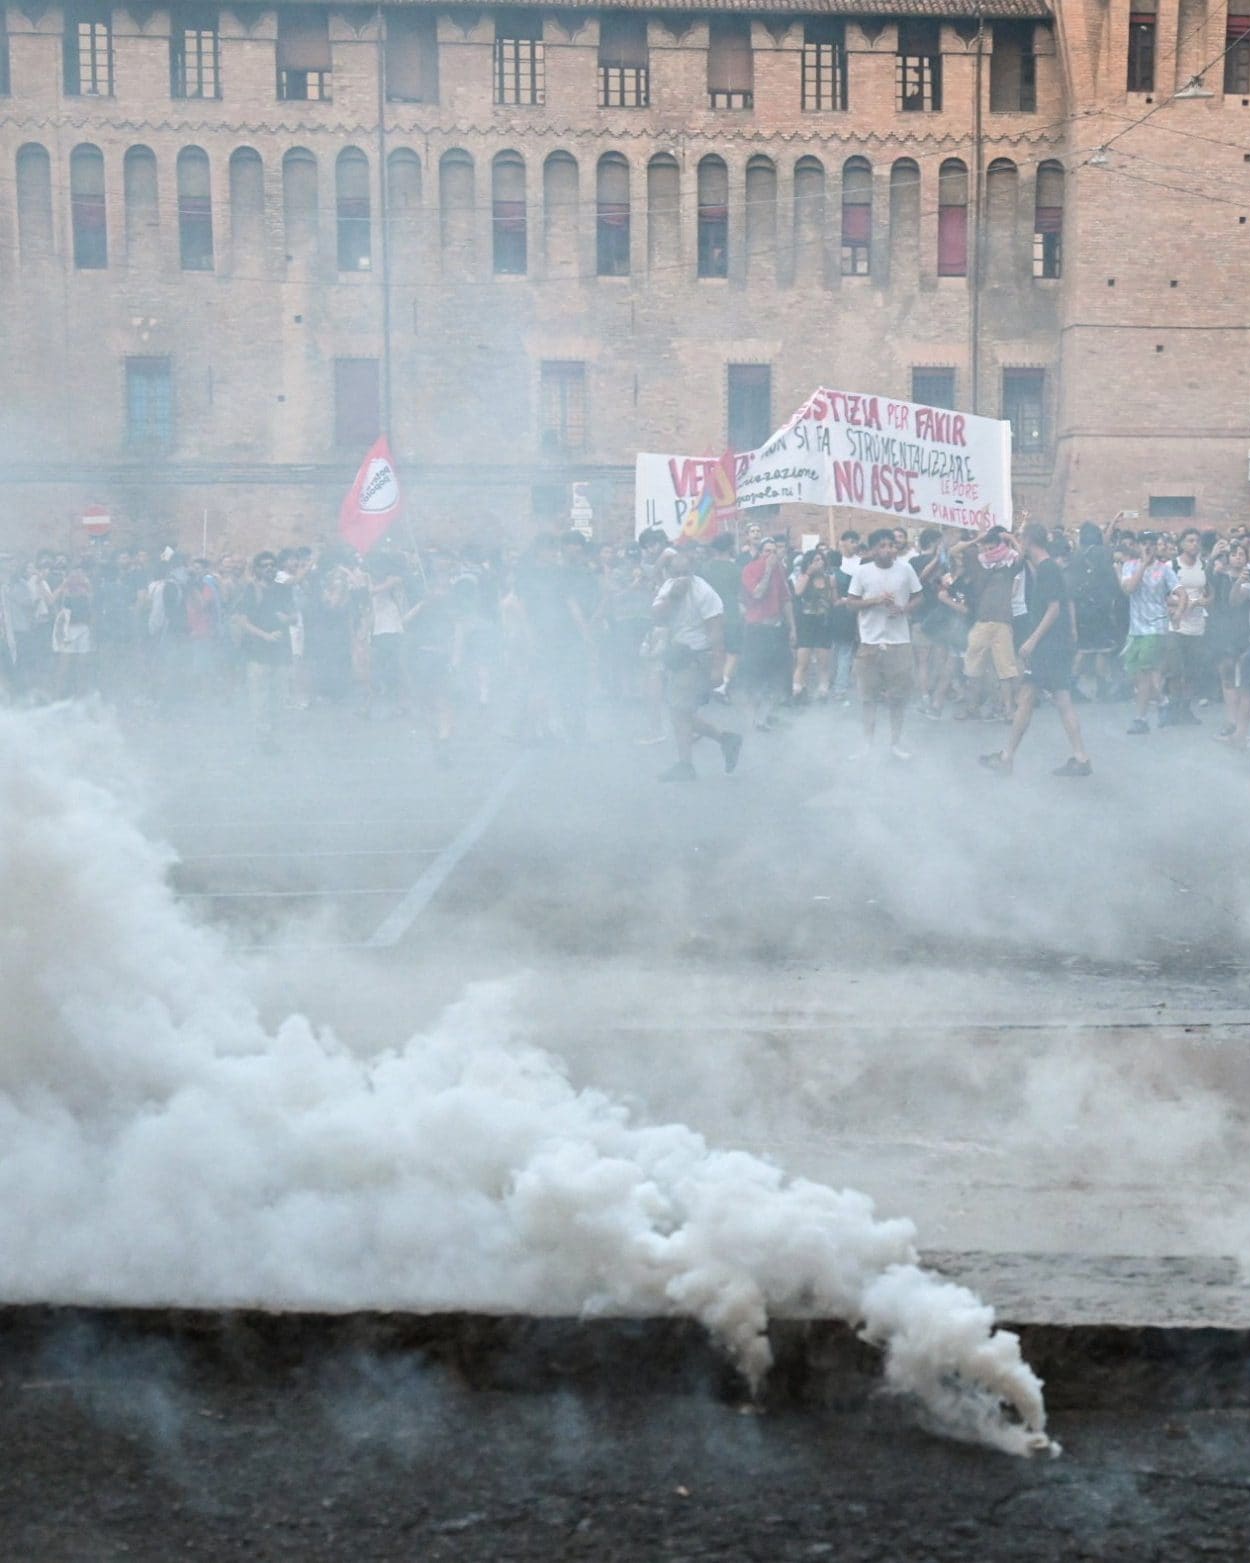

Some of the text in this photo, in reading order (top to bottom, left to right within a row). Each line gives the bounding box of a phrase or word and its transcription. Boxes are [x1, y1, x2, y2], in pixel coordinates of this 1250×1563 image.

[887, 403, 909, 430] PER
[915, 407, 967, 447] FAKIR
[794, 424, 809, 451] SI
[816, 424, 831, 456] FA
[846, 427, 976, 482] STRUMENTALIZZARE
[646, 498, 663, 525] IL
[833, 460, 921, 514] NO ASSE
